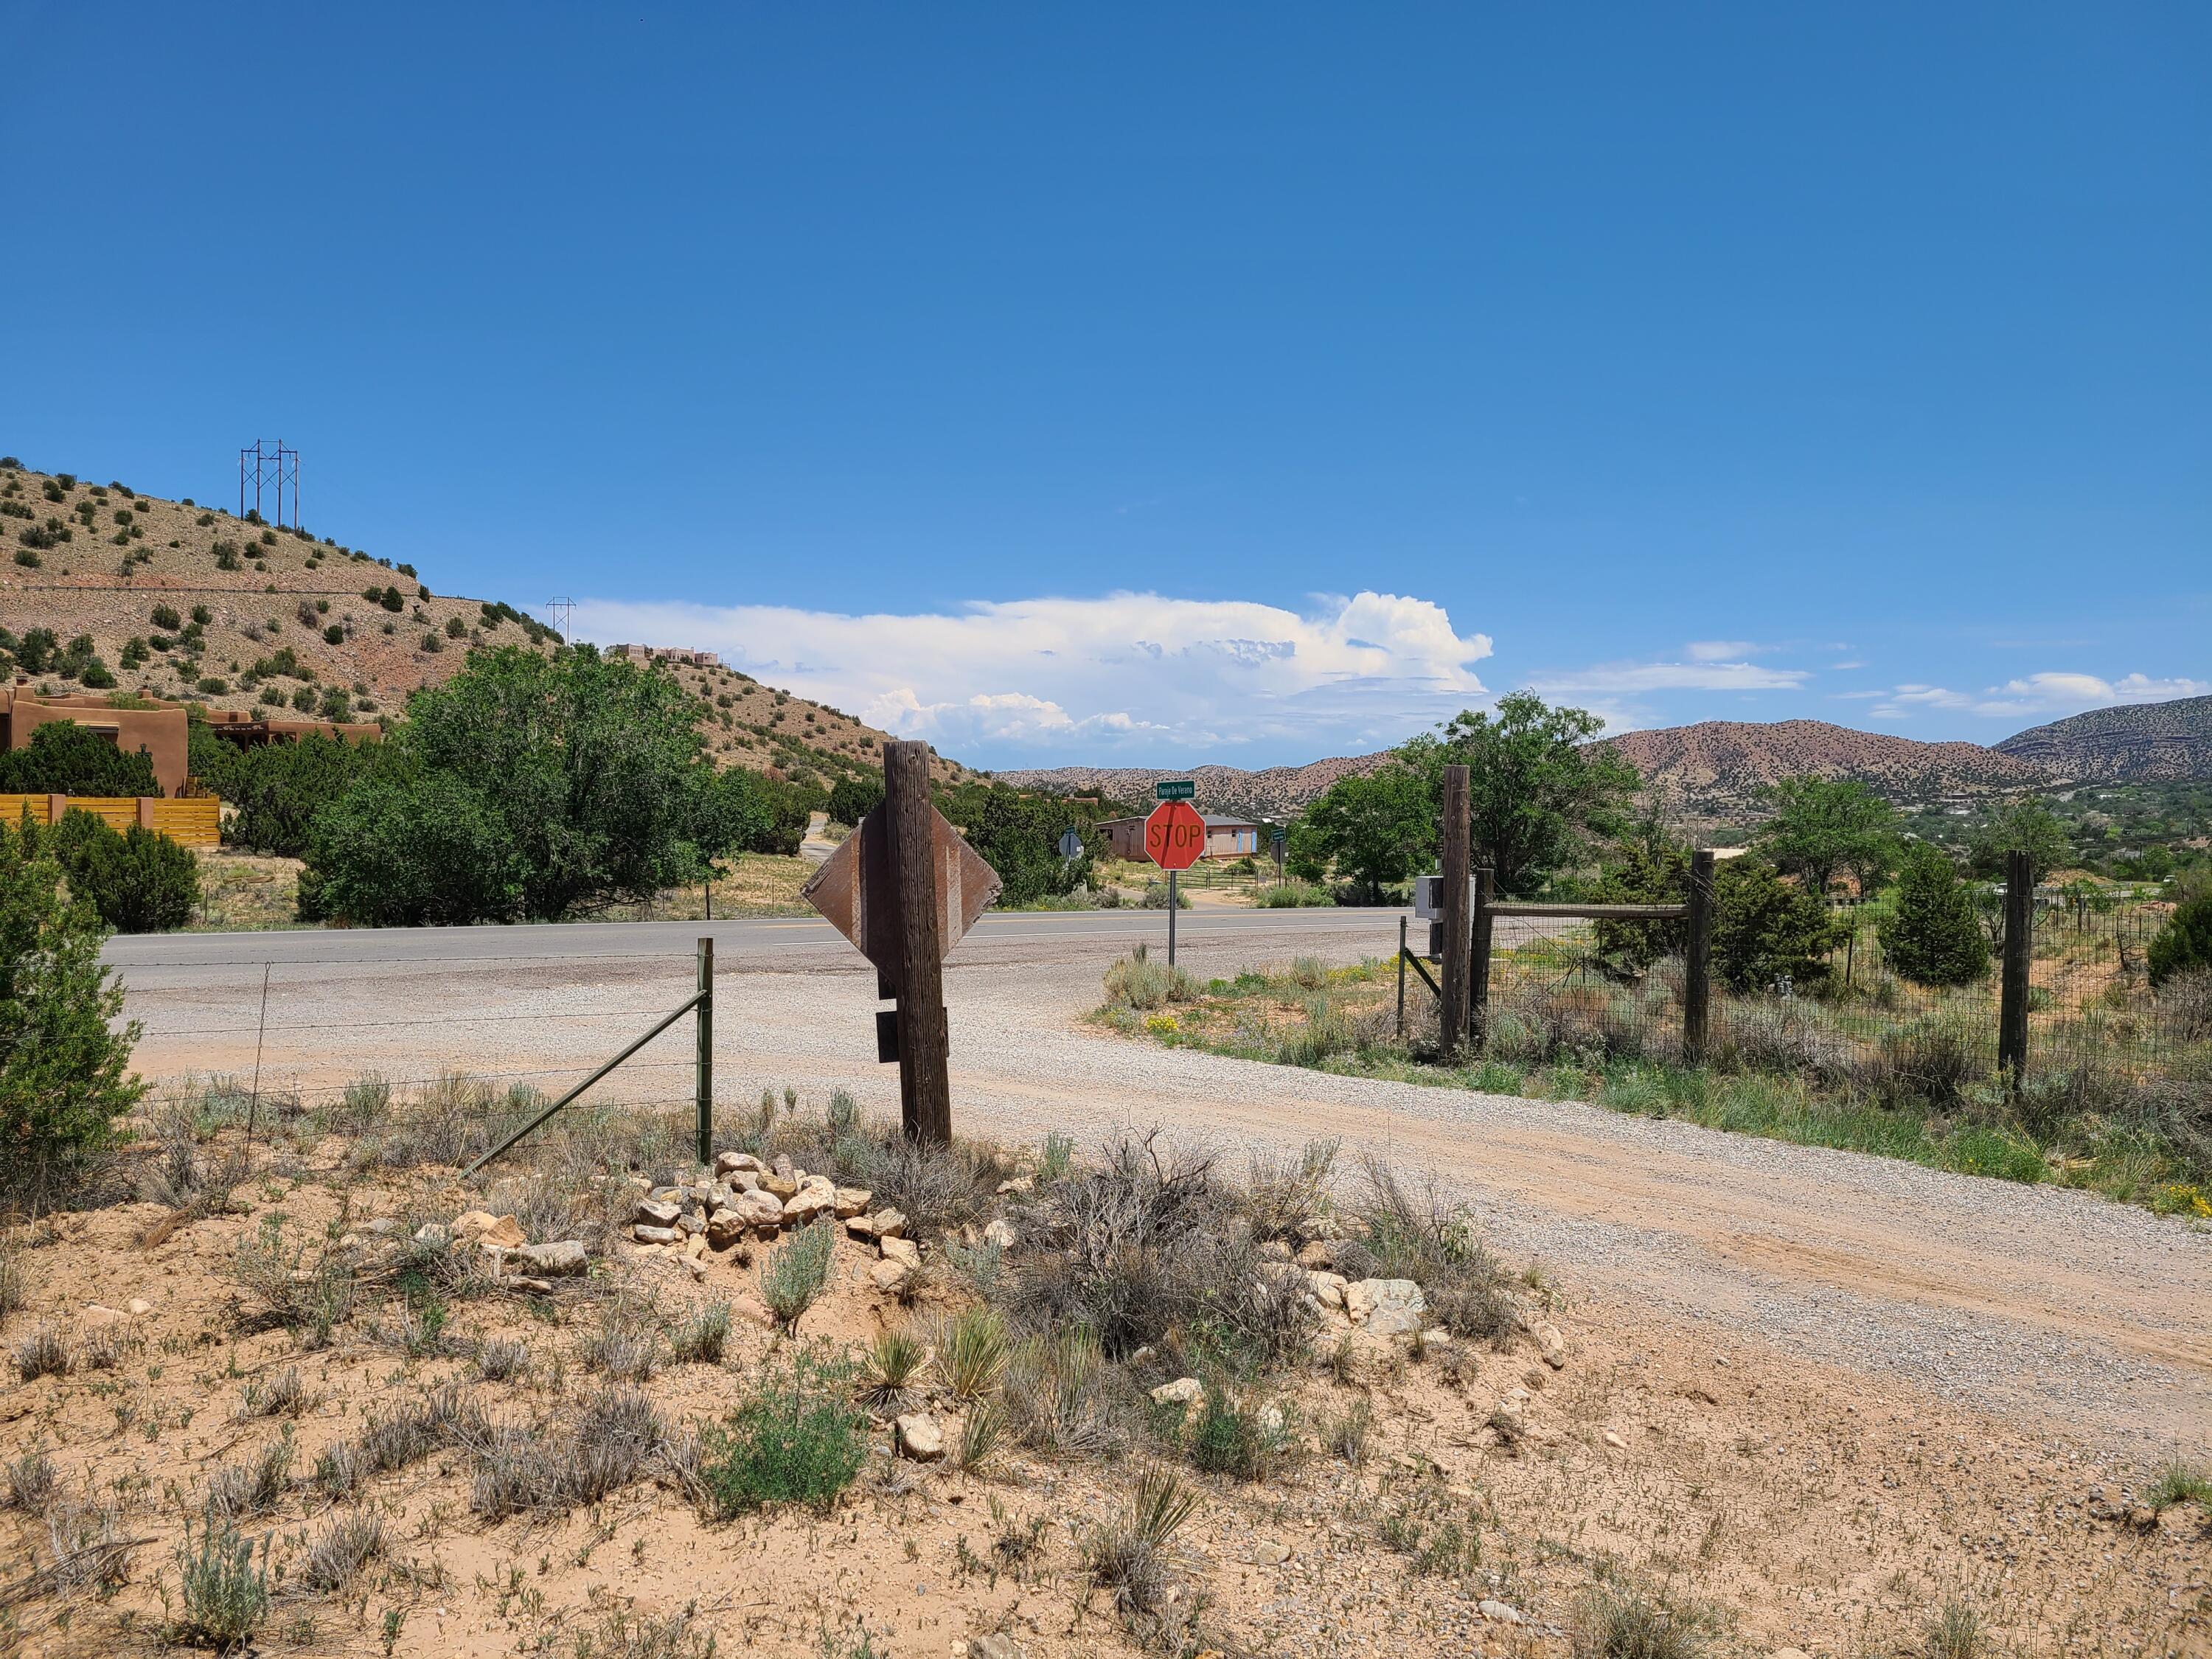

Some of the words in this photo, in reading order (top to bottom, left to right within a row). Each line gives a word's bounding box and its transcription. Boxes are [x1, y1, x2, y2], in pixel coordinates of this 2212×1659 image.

[1158, 787, 1171, 797] Paraje
[1172, 786, 1177, 795] De
[1178, 785, 1192, 794] Verano
[1150, 824, 1201, 848] STOP
